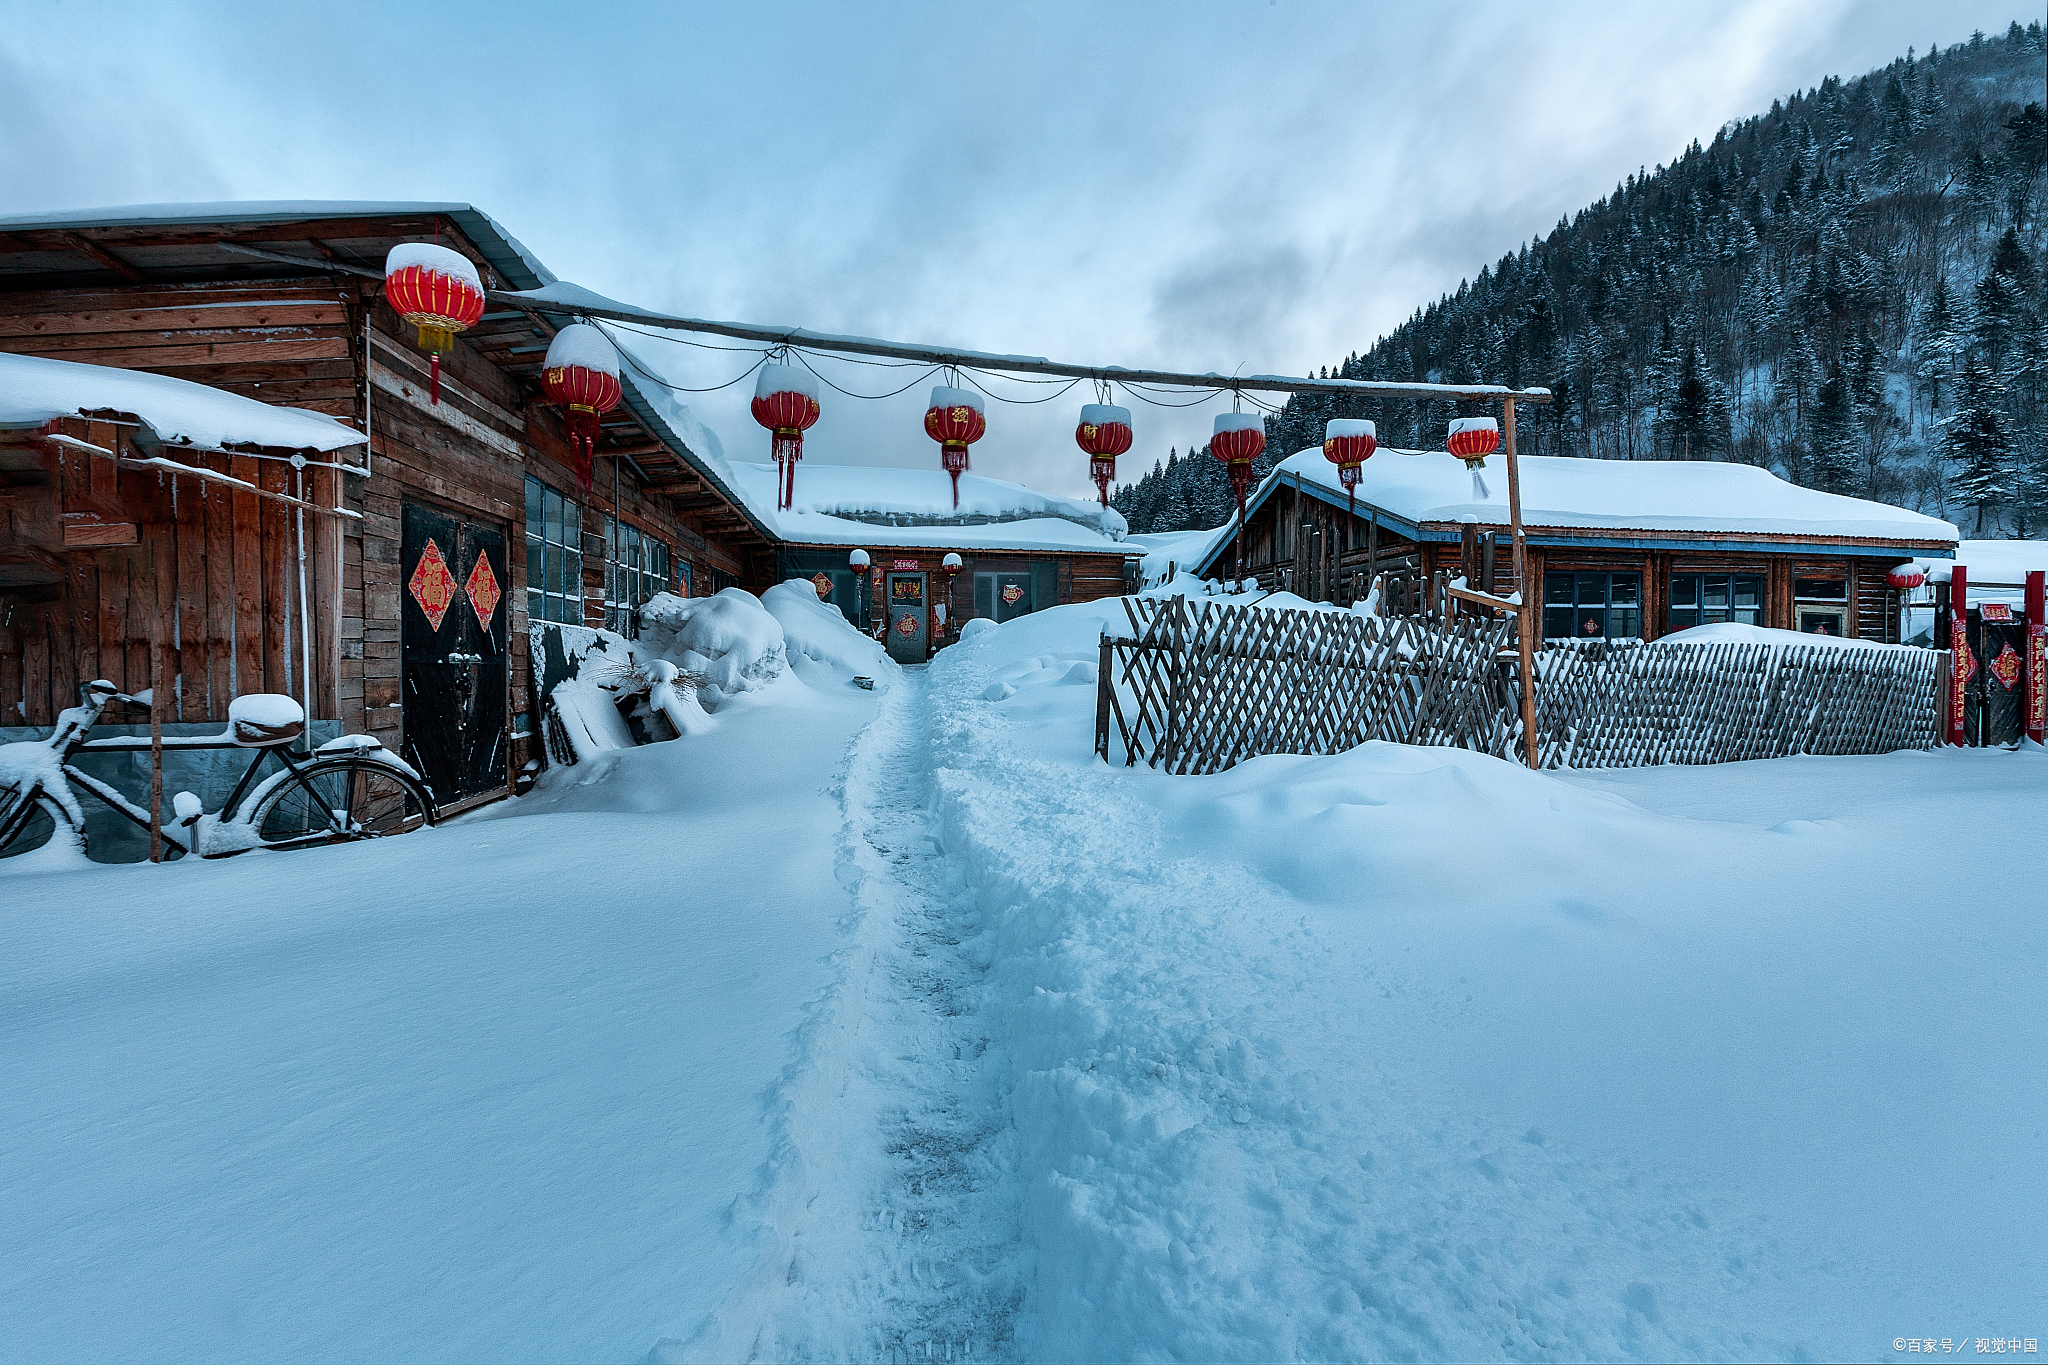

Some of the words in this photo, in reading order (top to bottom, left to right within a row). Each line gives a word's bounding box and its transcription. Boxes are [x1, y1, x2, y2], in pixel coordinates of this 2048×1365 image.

[1084, 425, 1098, 440] 財
[421, 558, 445, 609] 福
[475, 567, 493, 611] 福
[901, 617, 914, 632] 福
